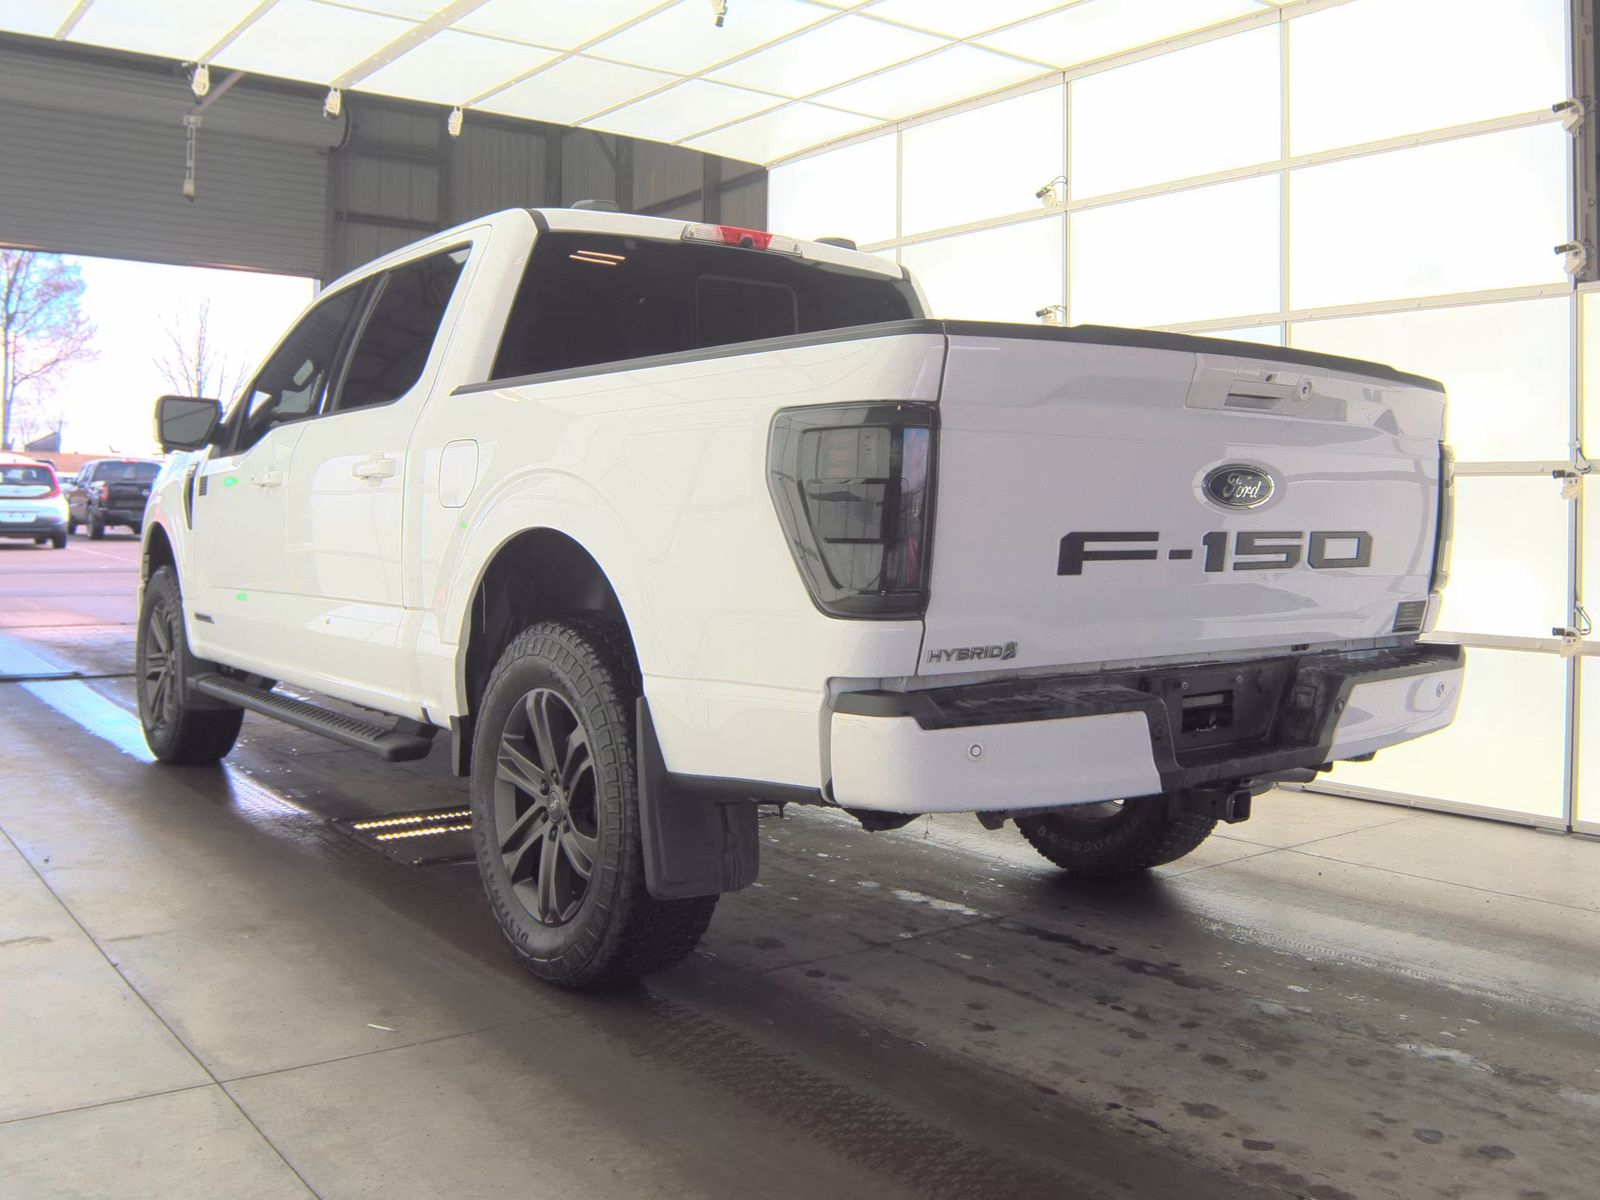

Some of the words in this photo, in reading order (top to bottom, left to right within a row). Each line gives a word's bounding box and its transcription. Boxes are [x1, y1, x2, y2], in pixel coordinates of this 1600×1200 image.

[1223, 473, 1262, 498] Ford
[1057, 531, 1372, 575] F-150
[928, 645, 1003, 663] HYBRID
